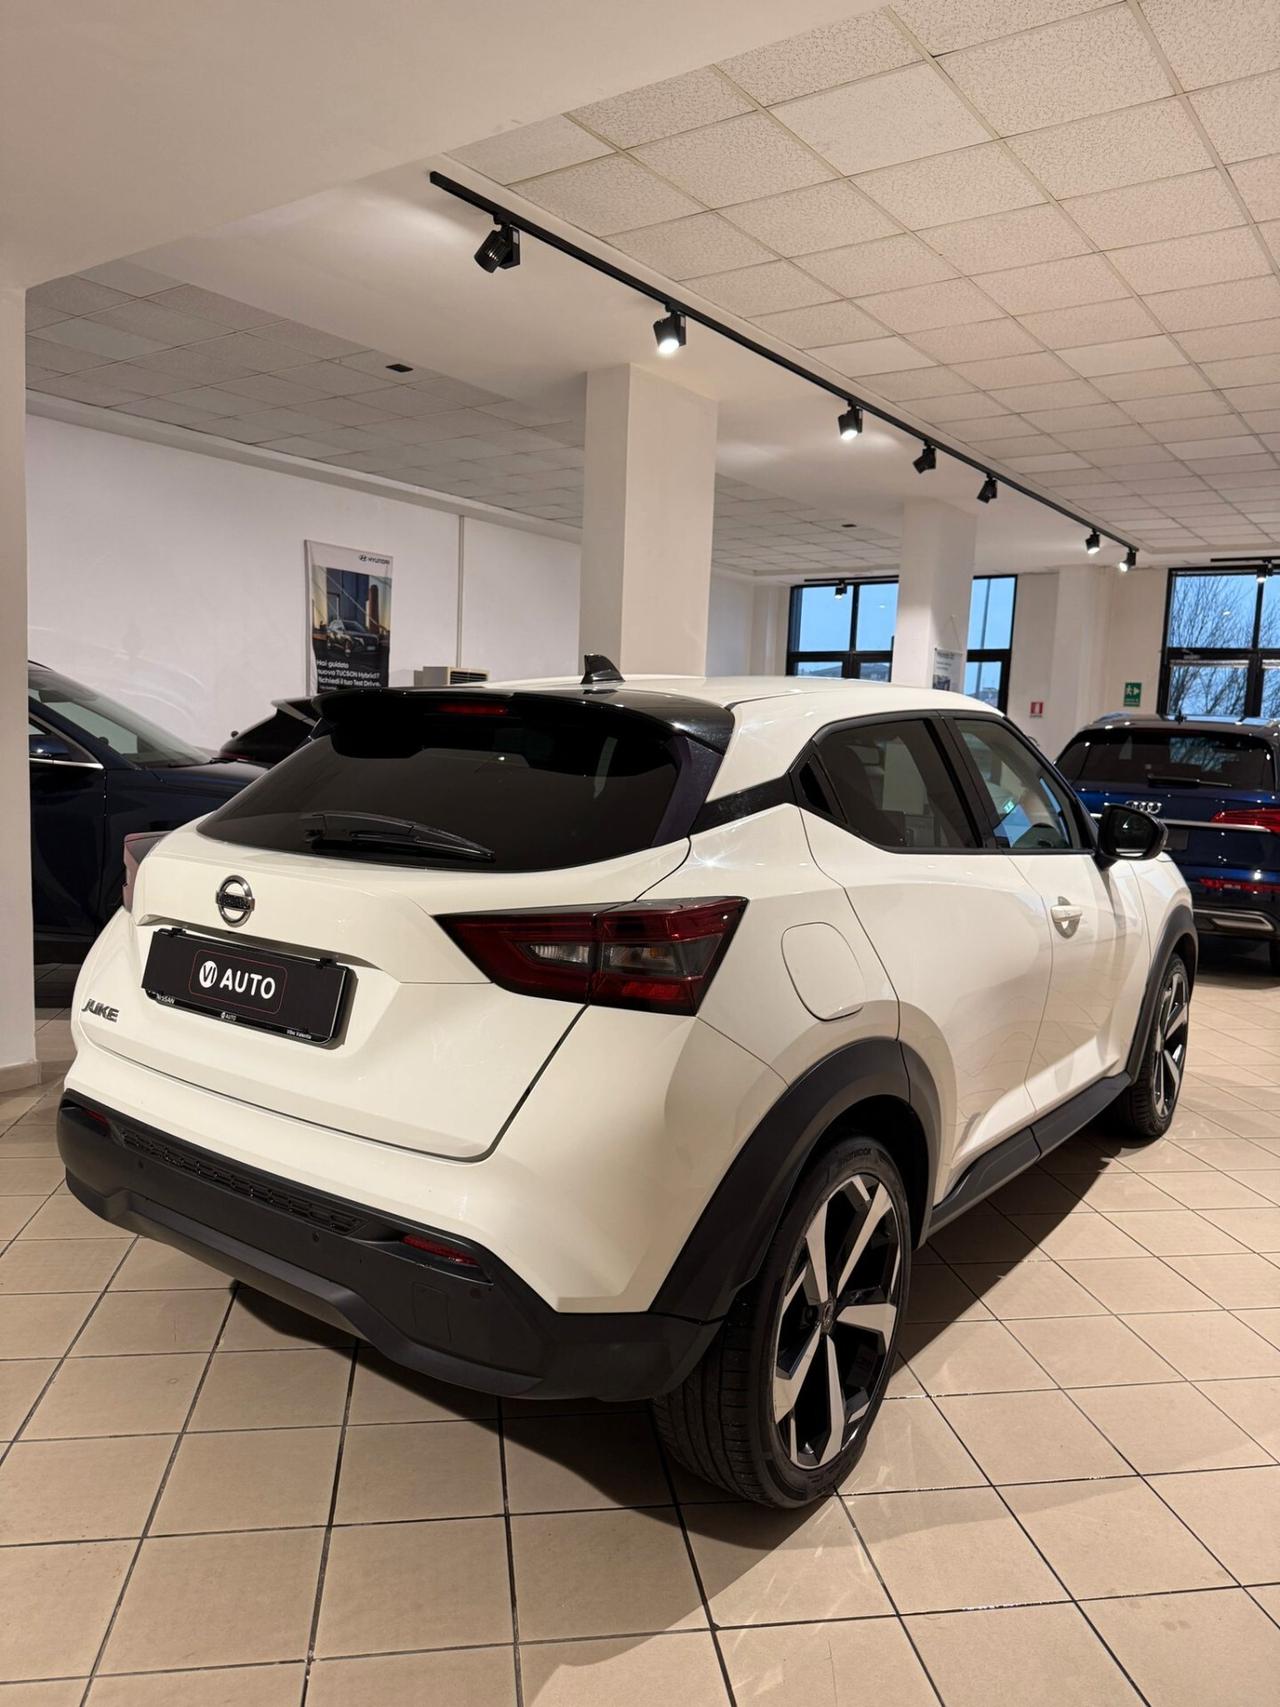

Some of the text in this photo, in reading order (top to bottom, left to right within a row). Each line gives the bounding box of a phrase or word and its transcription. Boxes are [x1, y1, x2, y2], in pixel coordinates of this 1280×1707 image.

[336, 670, 357, 678] TUCSON
[220, 968, 276, 999] AUTO
[81, 998, 120, 1023] JUKE
